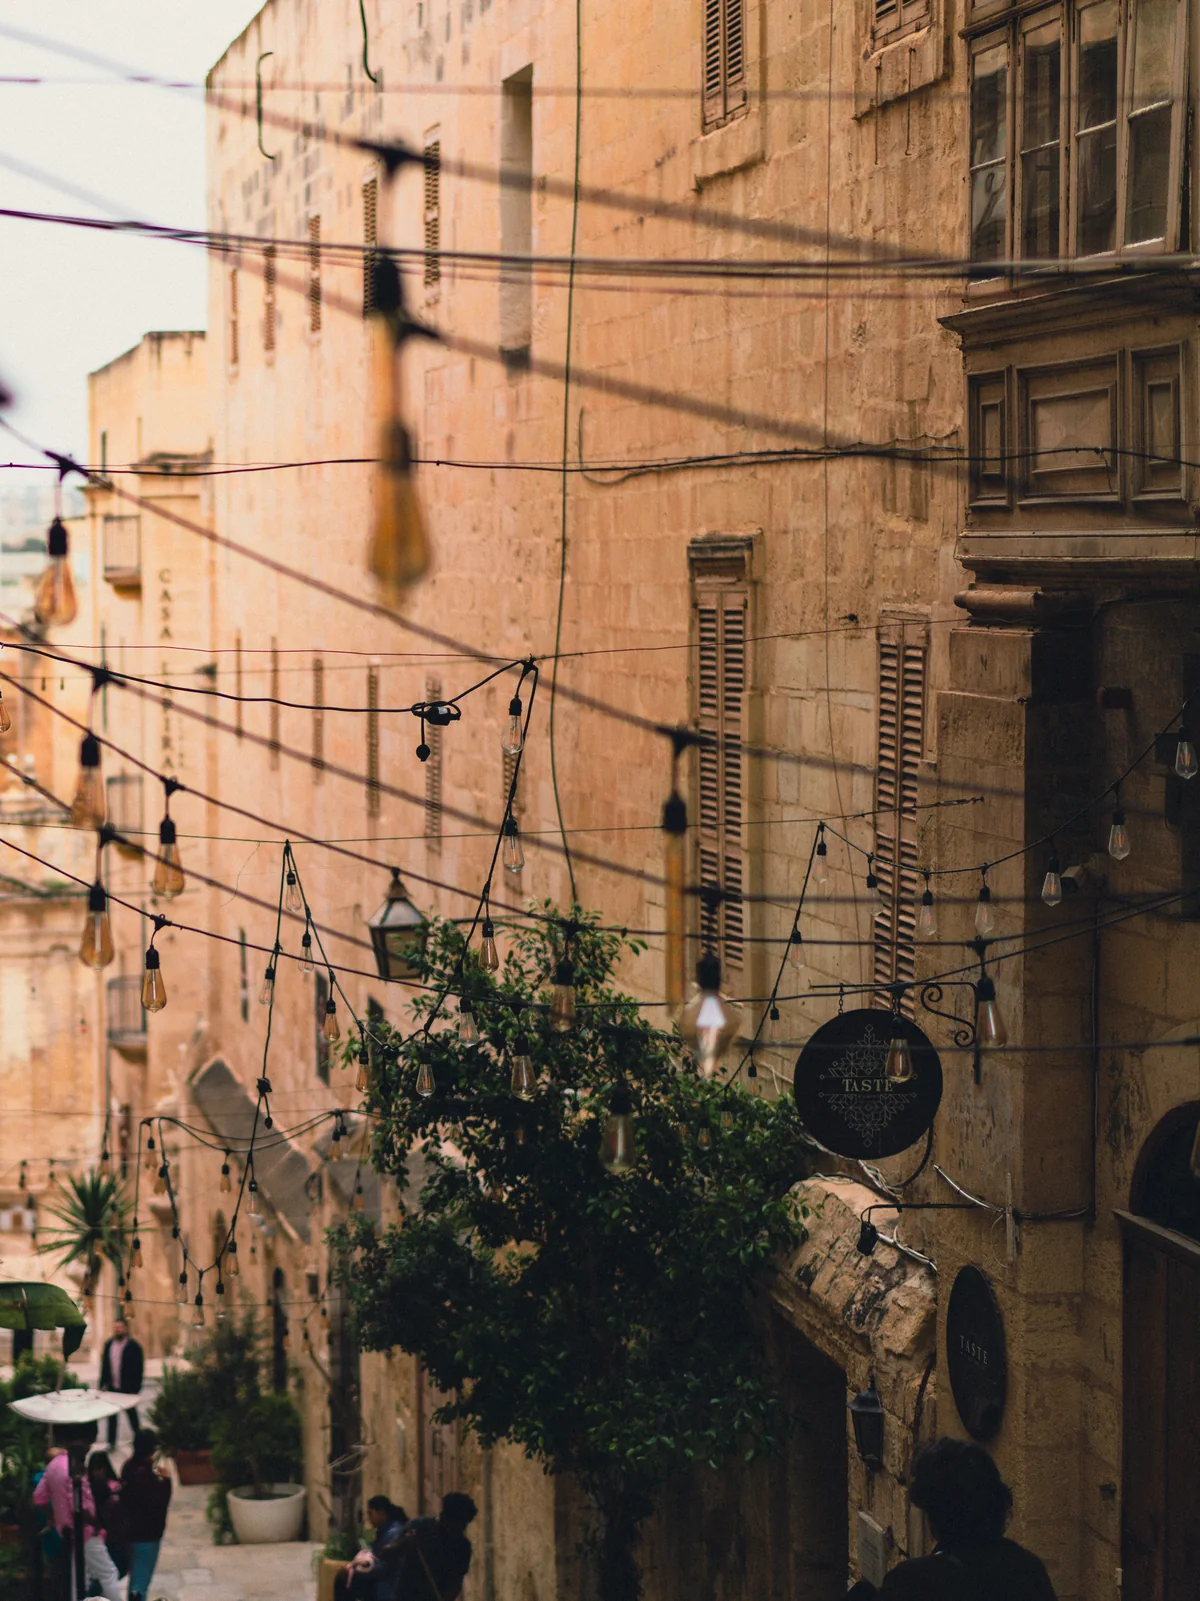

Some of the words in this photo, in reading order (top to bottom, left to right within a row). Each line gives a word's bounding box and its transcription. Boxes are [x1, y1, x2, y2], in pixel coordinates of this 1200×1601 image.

[159, 568, 173, 639] CASA
[841, 1078, 894, 1092] TASTE
[959, 1334, 988, 1365] TASTE
